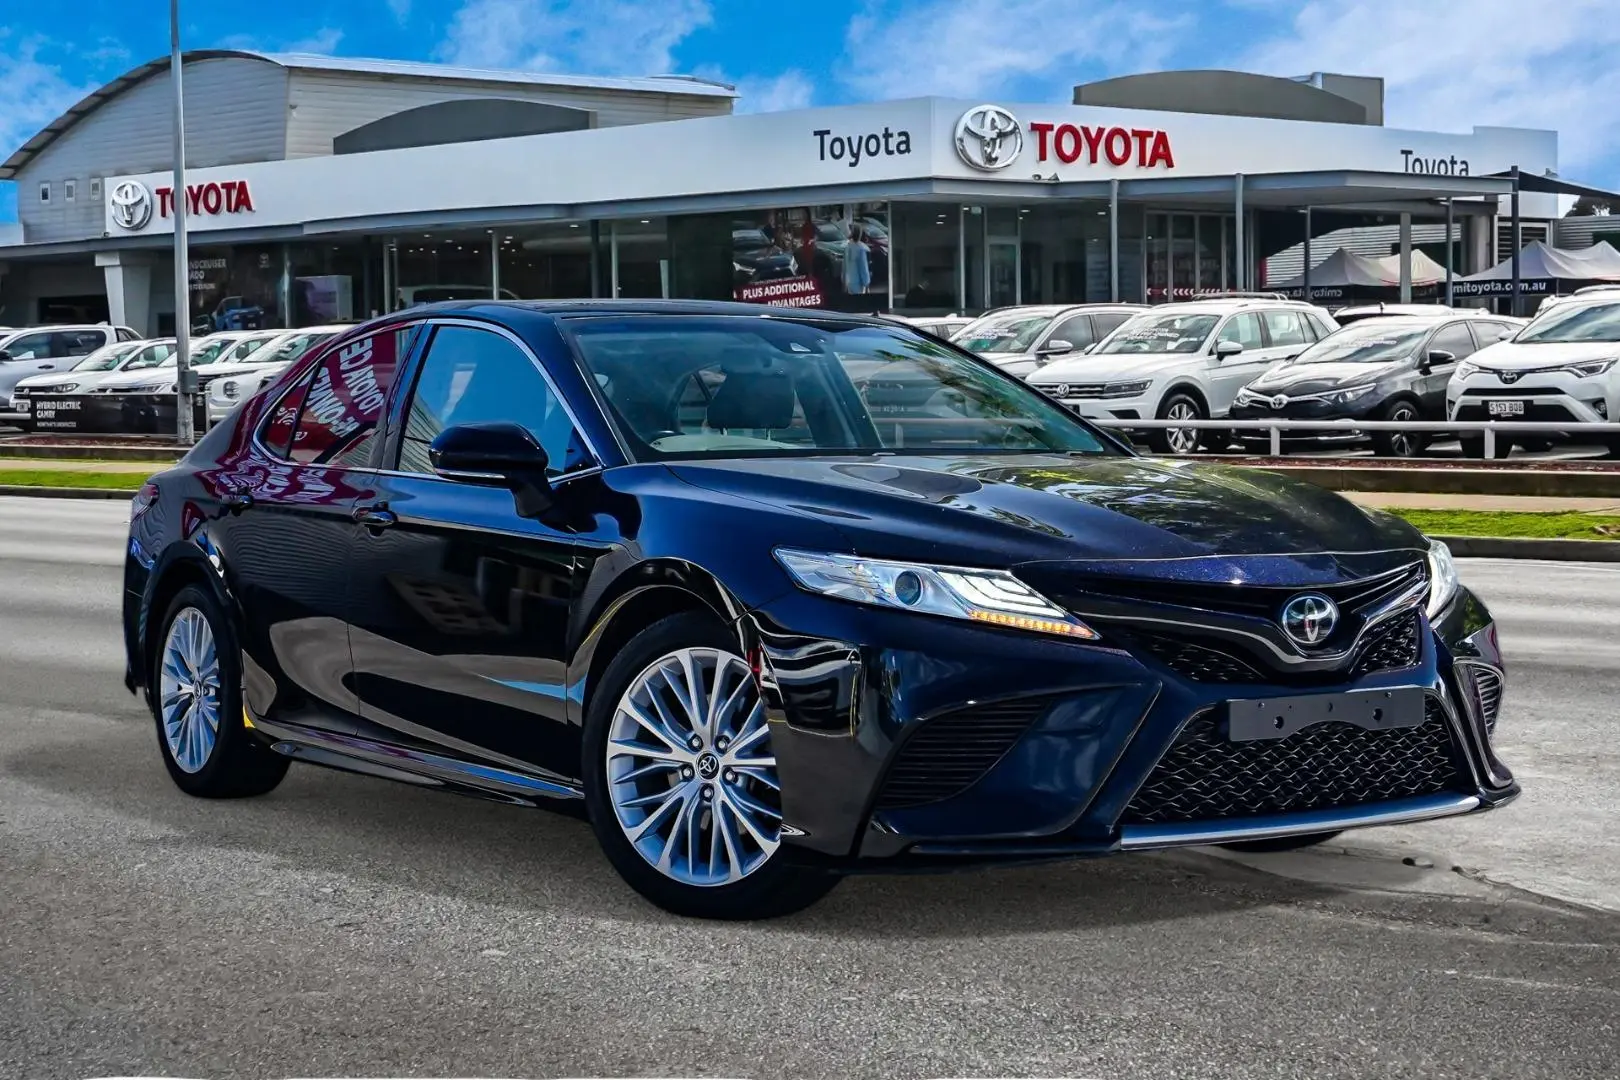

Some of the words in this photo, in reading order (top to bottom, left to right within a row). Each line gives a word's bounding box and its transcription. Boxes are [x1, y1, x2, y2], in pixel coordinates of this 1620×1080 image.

[813, 127, 912, 167] Toyota
[1030, 121, 1174, 168] TOYOTA
[743, 287, 763, 299] PLUS
[764, 281, 815, 297] ADDITIONAL
[1453, 281, 1546, 294] mitoyota.cm.au
